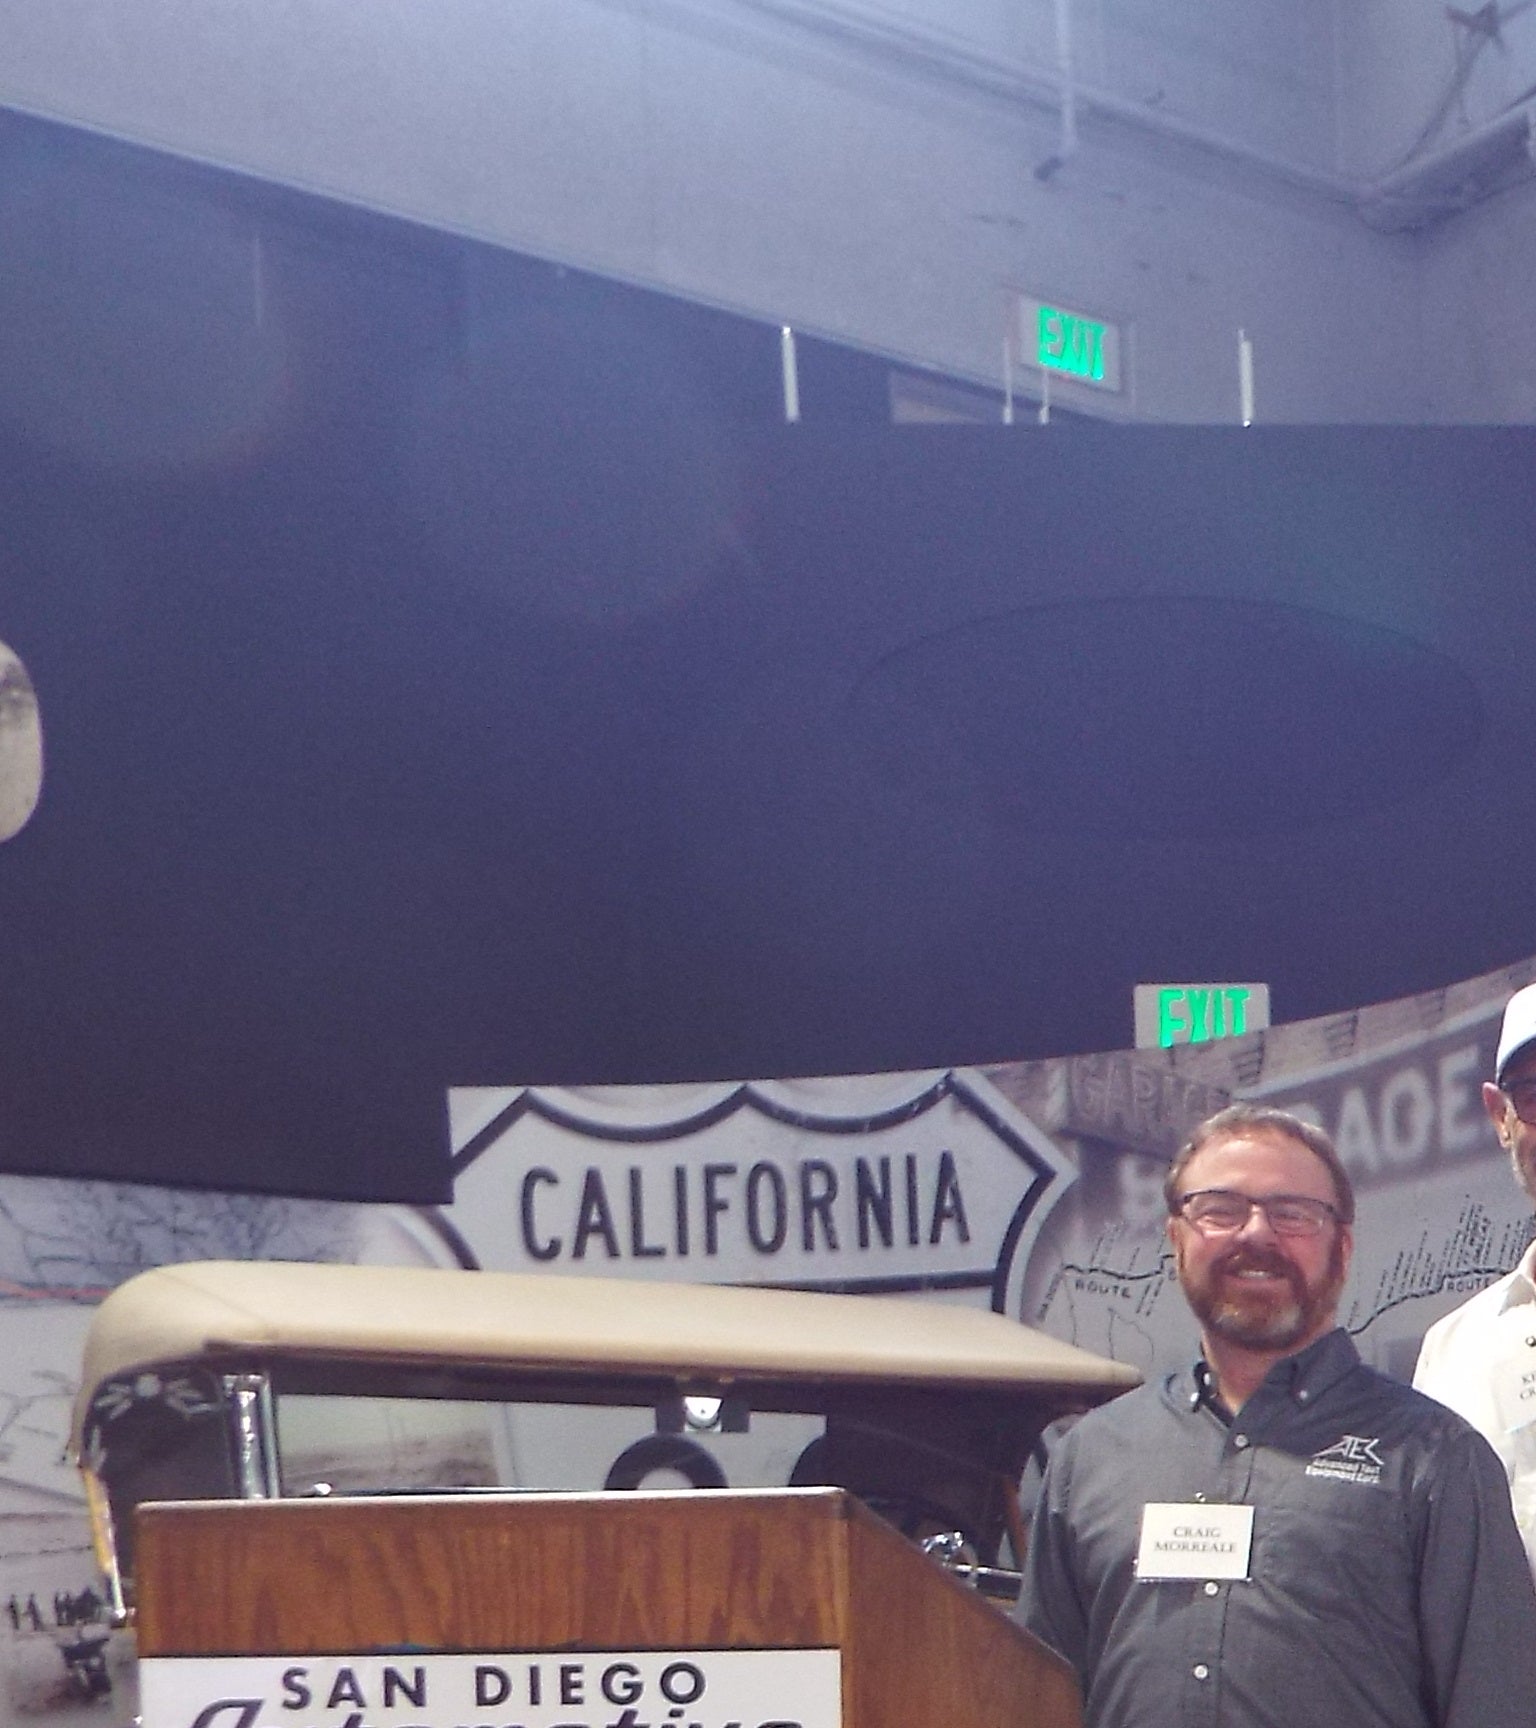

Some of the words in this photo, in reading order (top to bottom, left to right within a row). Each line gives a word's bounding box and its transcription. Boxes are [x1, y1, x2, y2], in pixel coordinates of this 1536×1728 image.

[1037, 304, 1108, 381] EXIT
[1157, 987, 1251, 1049] EXIT
[520, 1149, 972, 1262] CALIFORNIA
[1075, 1279, 1131, 1298] ROUTE
[1153, 1541, 1237, 1553] MORREALE
[1173, 1526, 1222, 1539] CRAIG
[282, 1663, 427, 1711] SAN
[475, 1661, 707, 1707] DIEGO
